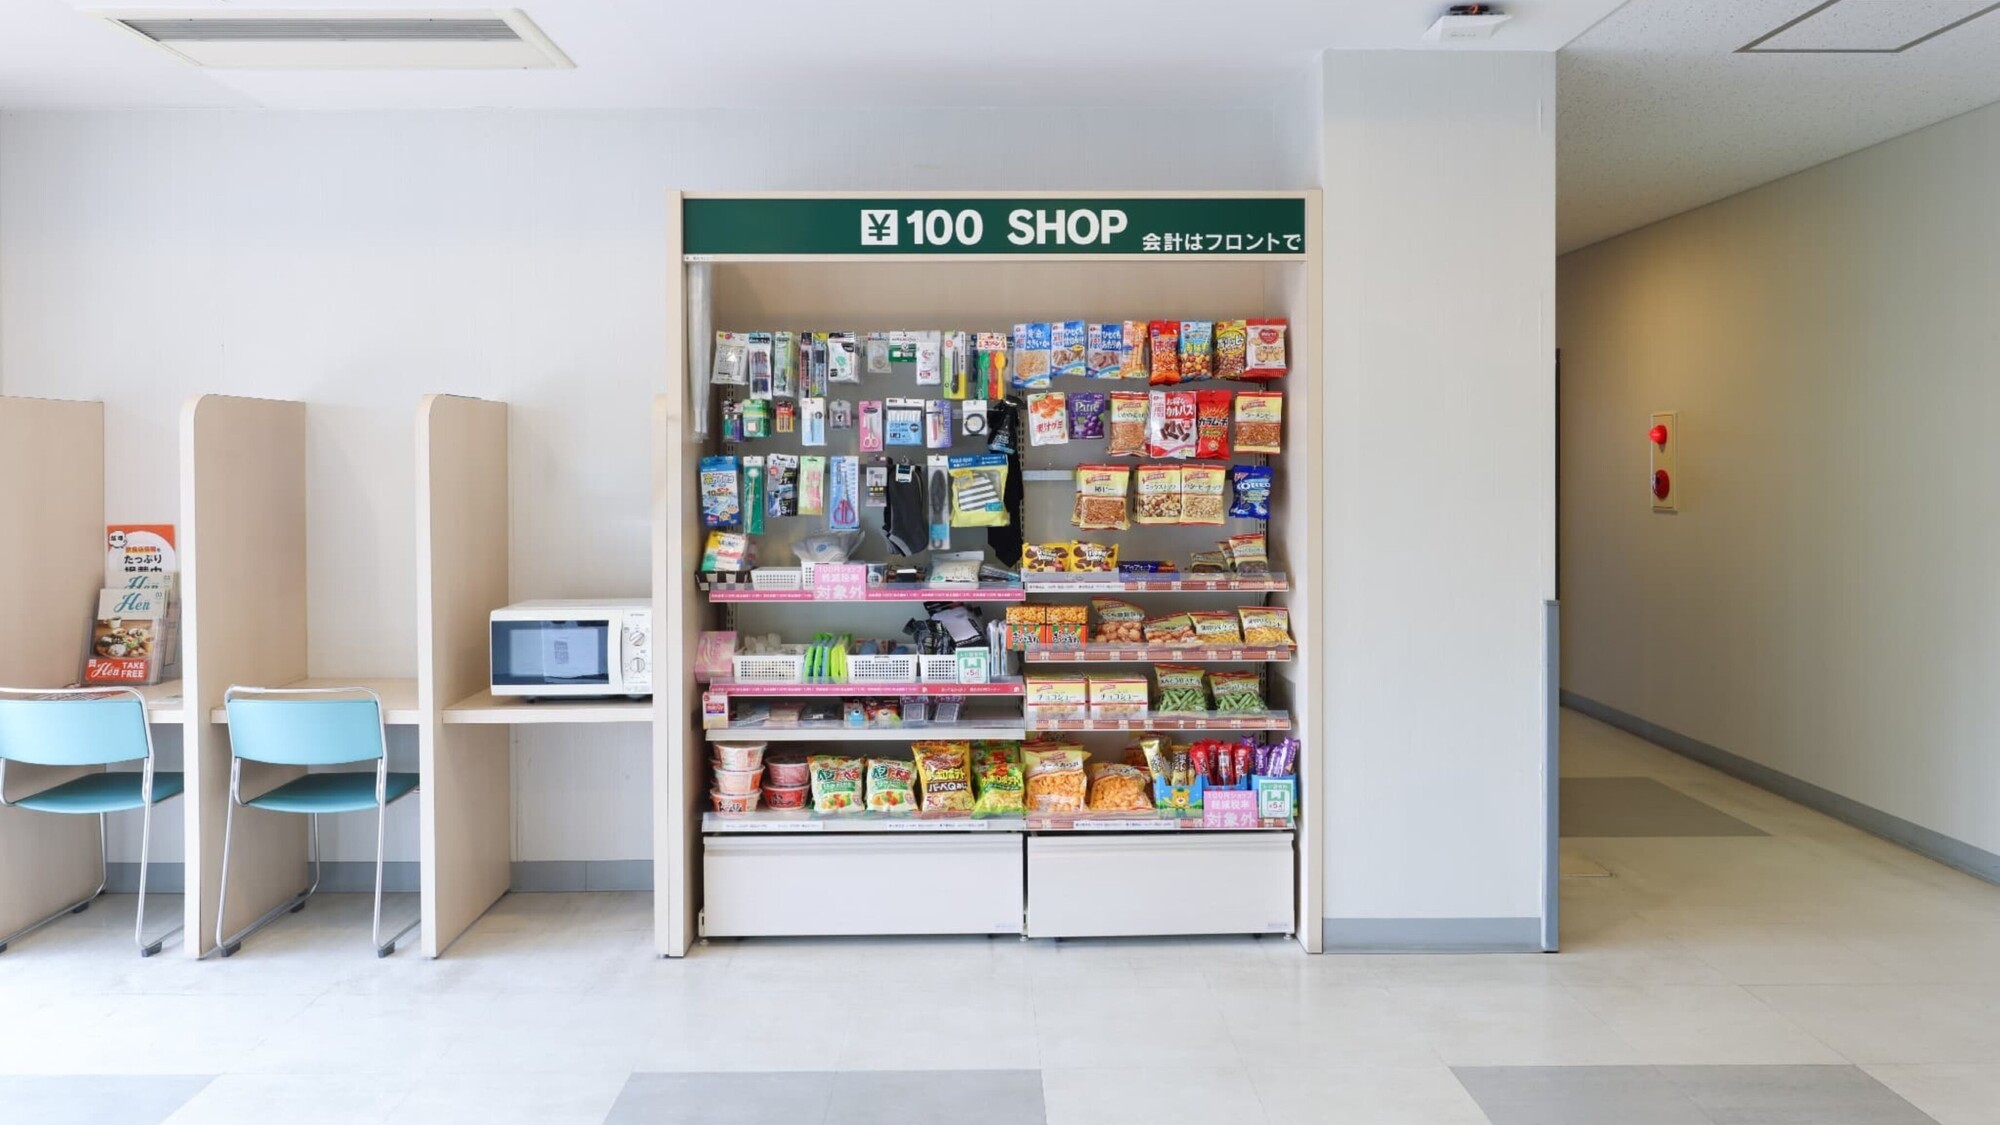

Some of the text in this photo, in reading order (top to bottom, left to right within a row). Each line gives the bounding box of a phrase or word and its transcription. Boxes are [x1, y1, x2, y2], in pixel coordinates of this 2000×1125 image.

[1006, 208, 1128, 246] SHOP
[1142, 232, 1302, 251] 会計はフロントで
[1166, 404, 1194, 416] カルパス
[1036, 421, 1063, 433] 果汁グミ
[124, 555, 162, 564] たっぷり
[815, 586, 864, 600] 対象外
[114, 592, 150, 613] Hen
[122, 661, 145, 669] TAKE
[121, 670, 144, 678] FREE
[1206, 812, 1254, 826] 対象外
